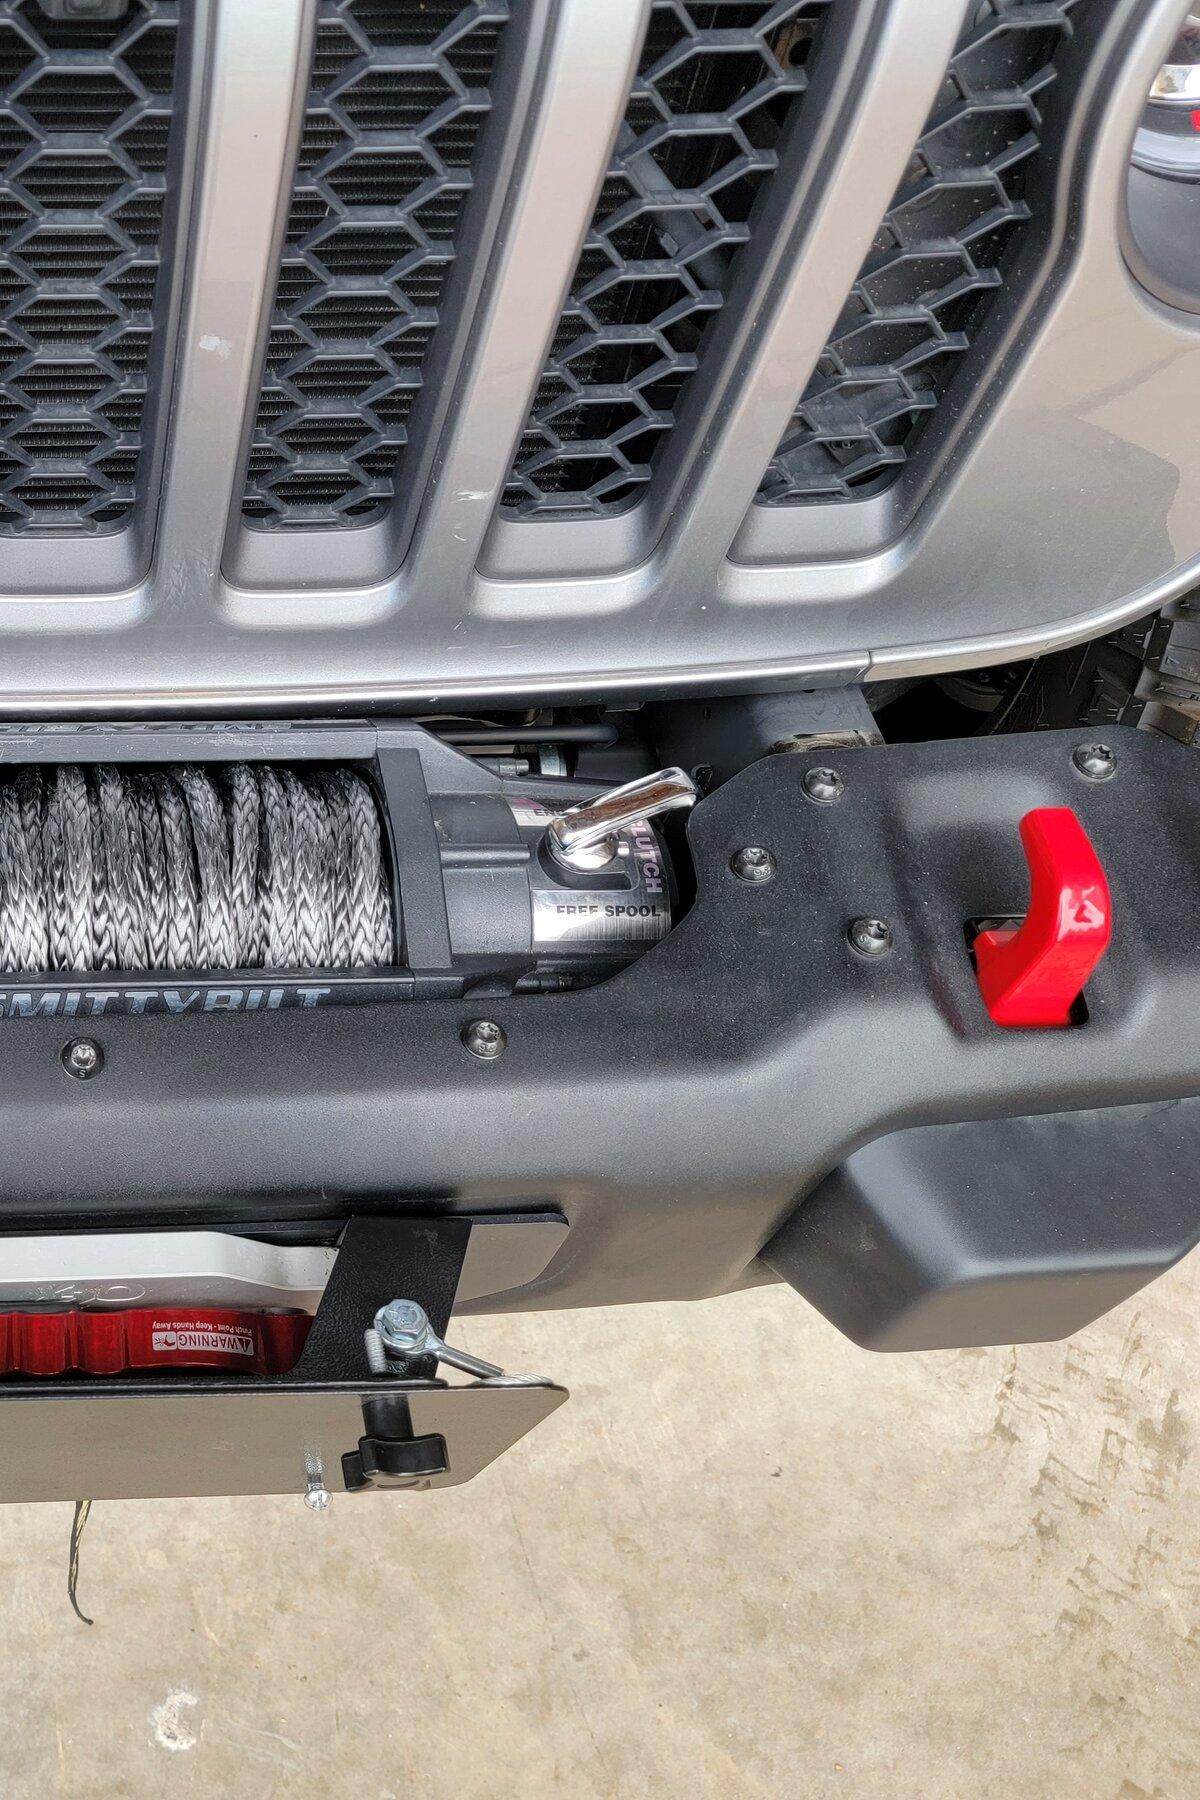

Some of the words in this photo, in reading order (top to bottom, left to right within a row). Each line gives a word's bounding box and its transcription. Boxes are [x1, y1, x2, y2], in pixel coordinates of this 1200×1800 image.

[556, 904, 599, 916] FREE
[604, 904, 662, 917] SPOOL
[152, 1321, 171, 1330] Away
[172, 1321, 194, 1330] Hands
[195, 1321, 213, 1331] Keep
[218, 1323, 234, 1332] Point
[235, 1326, 253, 1336] Pinch
[178, 1334, 238, 1350] WARNING
